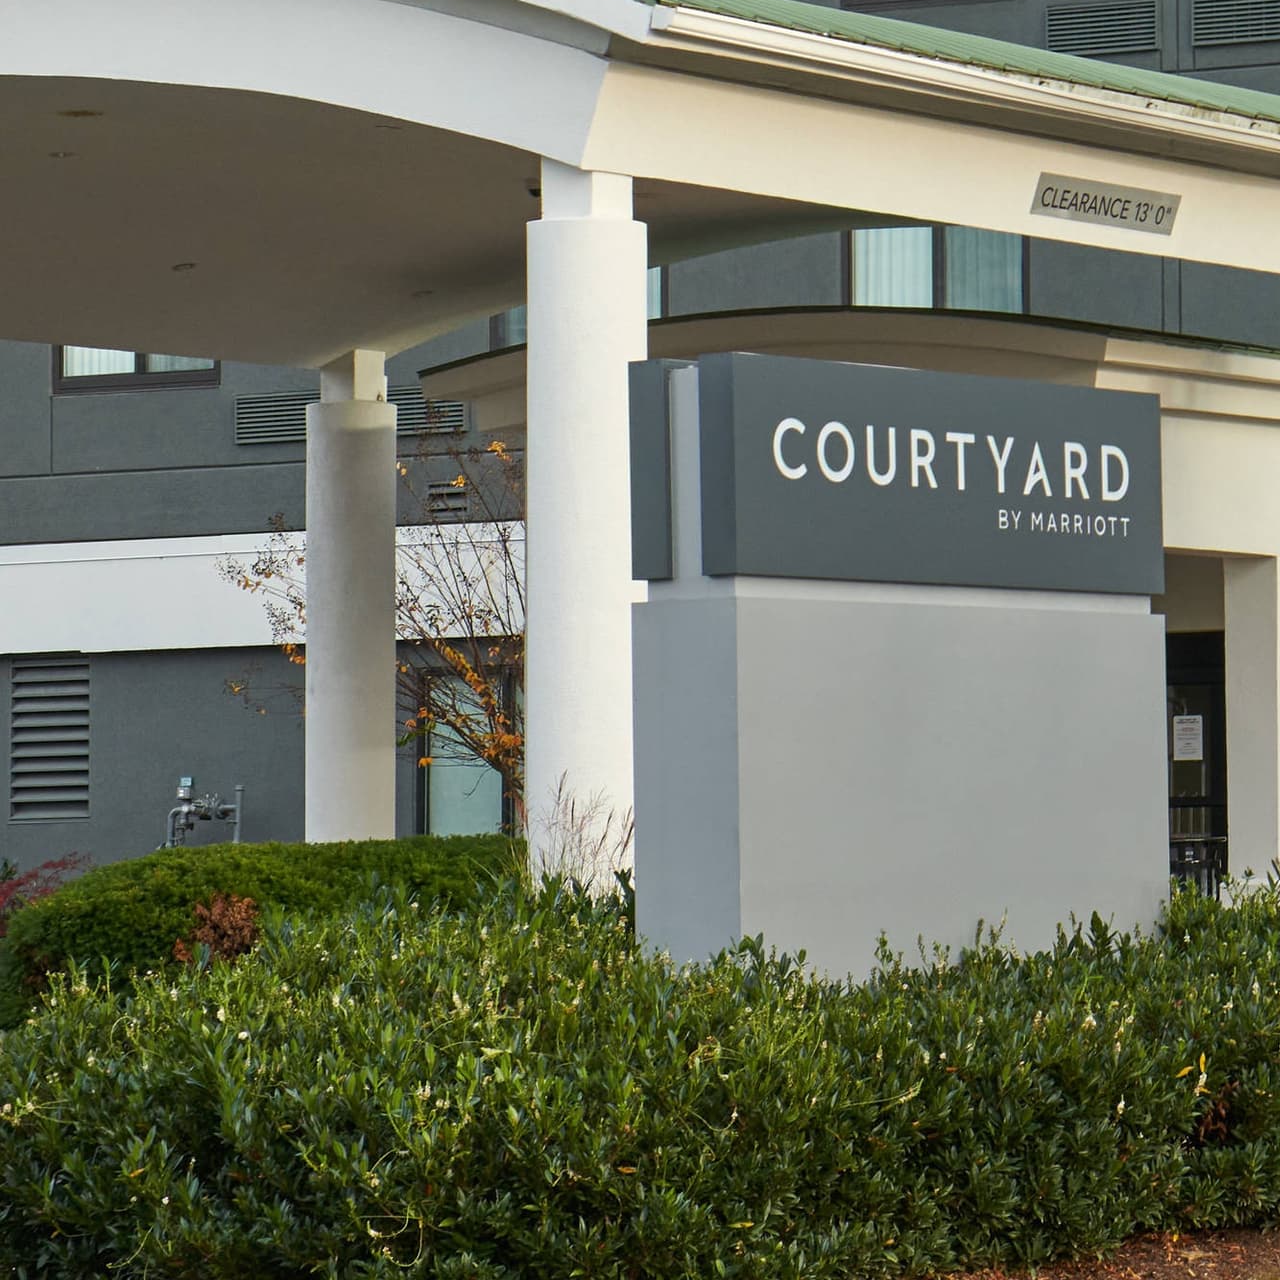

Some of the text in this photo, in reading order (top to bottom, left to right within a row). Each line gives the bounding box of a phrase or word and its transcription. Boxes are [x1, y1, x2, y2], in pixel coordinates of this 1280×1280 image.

[1041, 186, 1132, 220] CLEARANCE
[773, 417, 1130, 502] COURTYARD
[998, 509, 1130, 537] BY MARRIOTT
